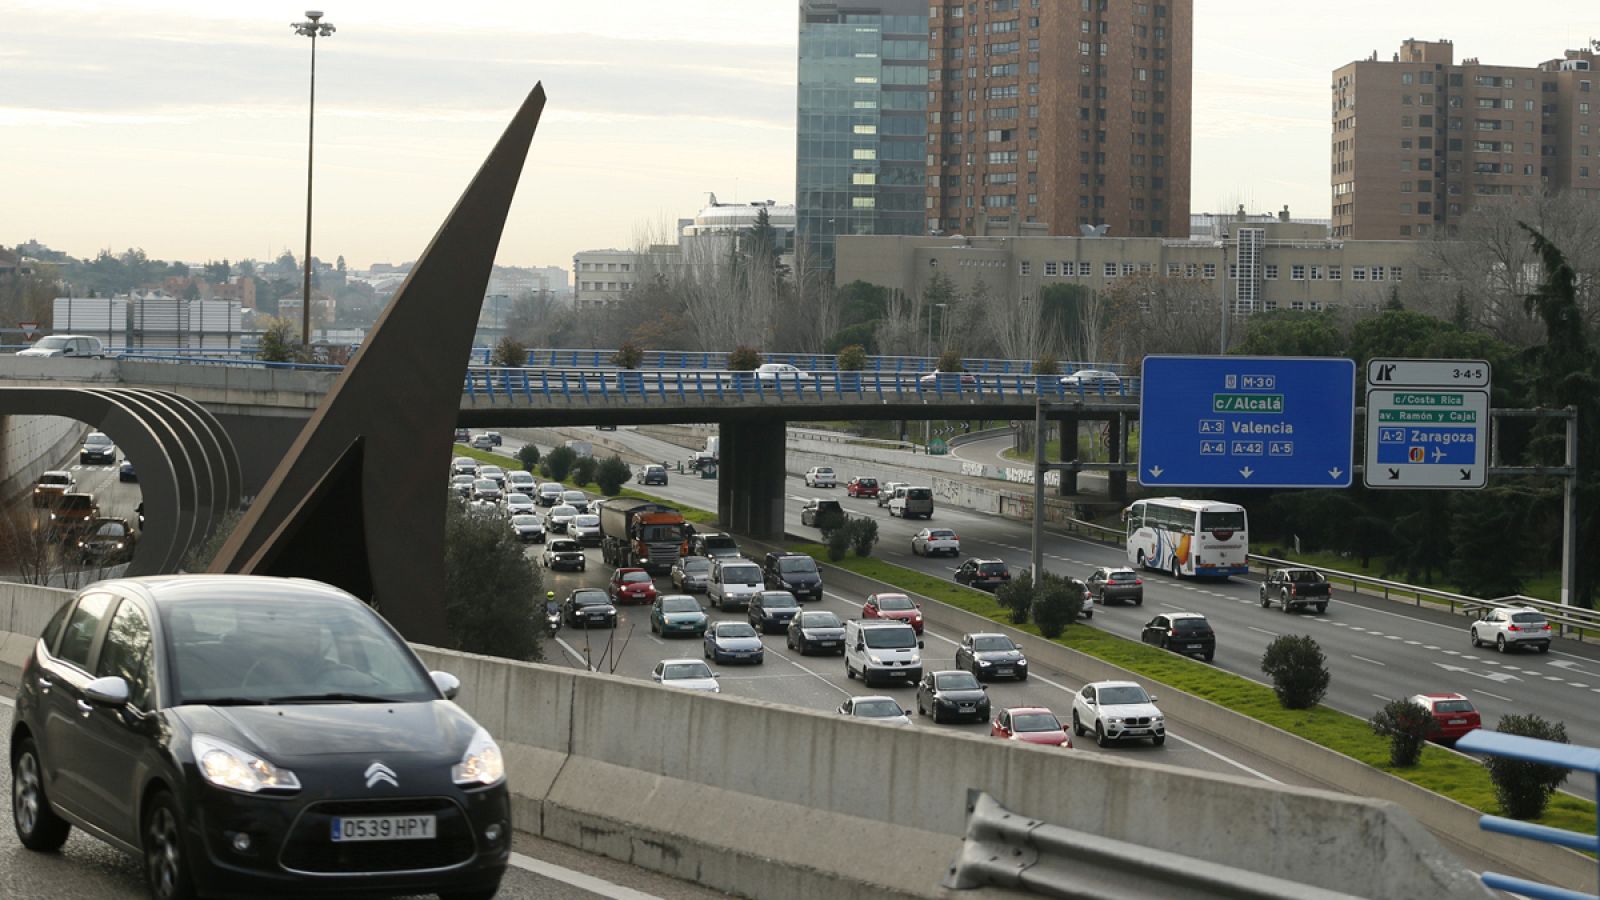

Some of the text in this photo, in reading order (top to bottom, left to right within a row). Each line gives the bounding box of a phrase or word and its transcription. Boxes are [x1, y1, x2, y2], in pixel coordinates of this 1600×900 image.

[1243, 377, 1273, 387] M-30
[1215, 396, 1281, 410] c/Alcalá
[1395, 395, 1461, 404] c/Costa Rica
[1400, 411, 1432, 420] Ramón
[1438, 413, 1444, 421] y
[1450, 412, 1476, 422] Cajal
[1201, 421, 1293, 434] A-3 Valencia
[1382, 430, 1474, 445] A-2 Zaragoza
[1202, 442, 1292, 454] A-4 A-42 A-5
[344, 818, 430, 837] 0539 HPY
